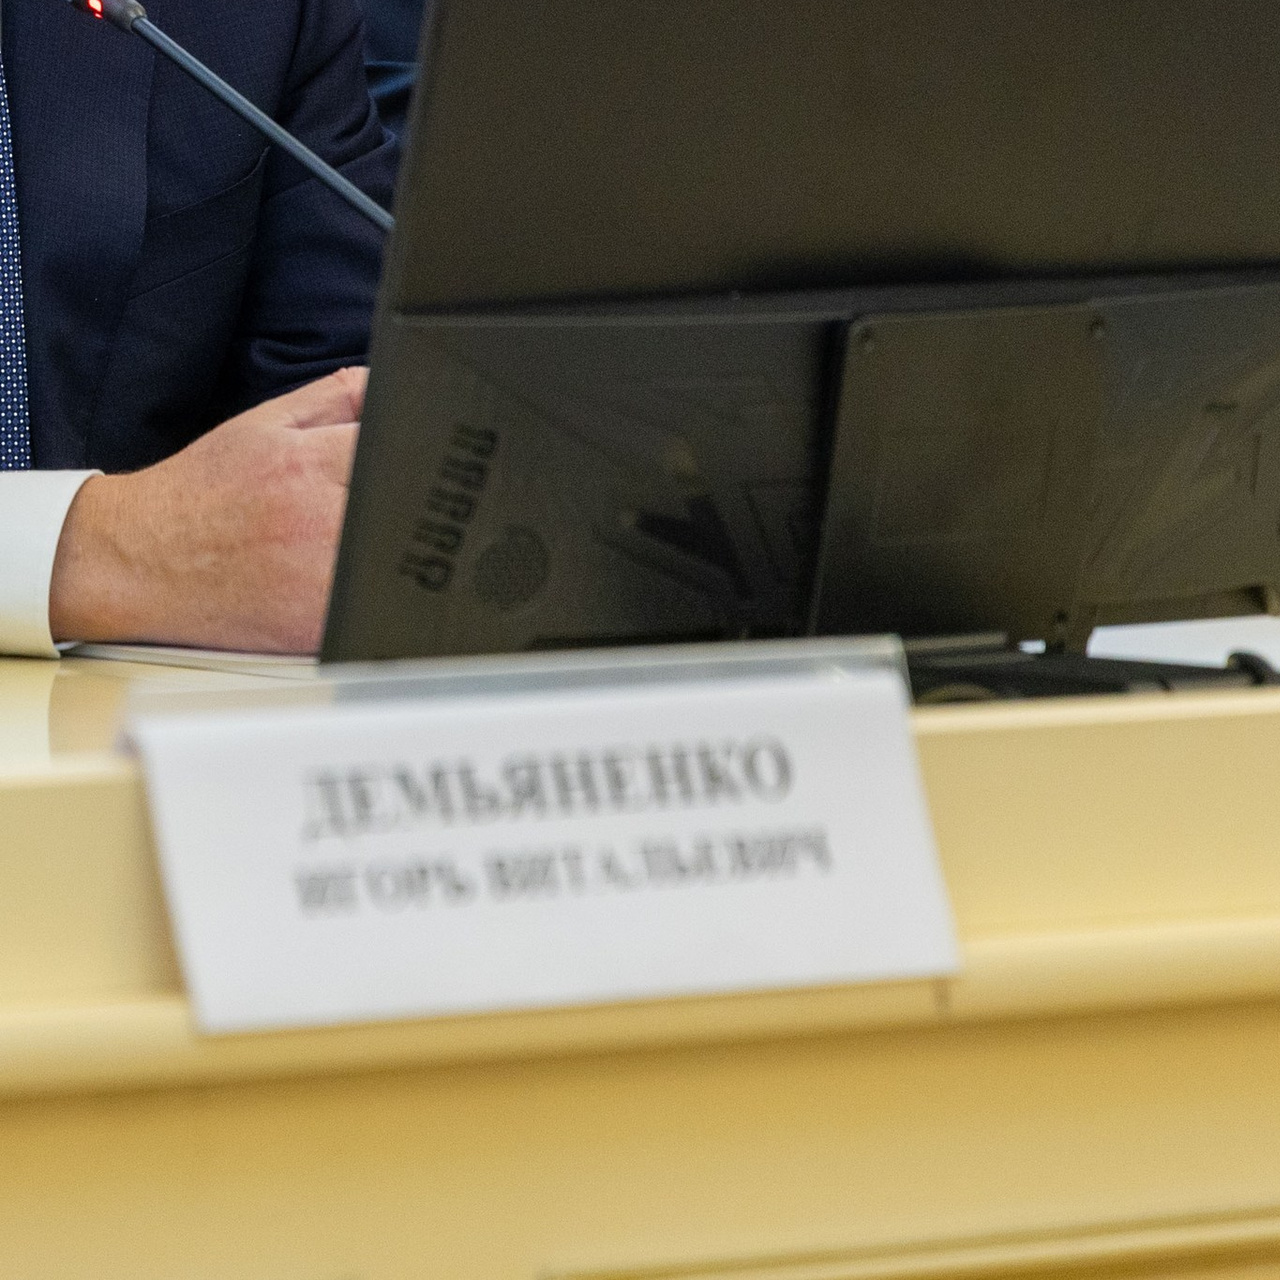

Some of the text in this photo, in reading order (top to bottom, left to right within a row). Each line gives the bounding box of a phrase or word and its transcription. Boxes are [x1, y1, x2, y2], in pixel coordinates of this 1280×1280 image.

[300, 736, 795, 841] ДЕМЬЯНЕНКО
[293, 829, 836, 920] ИГОРЬ ВИТАЛЬЕВИЧ
